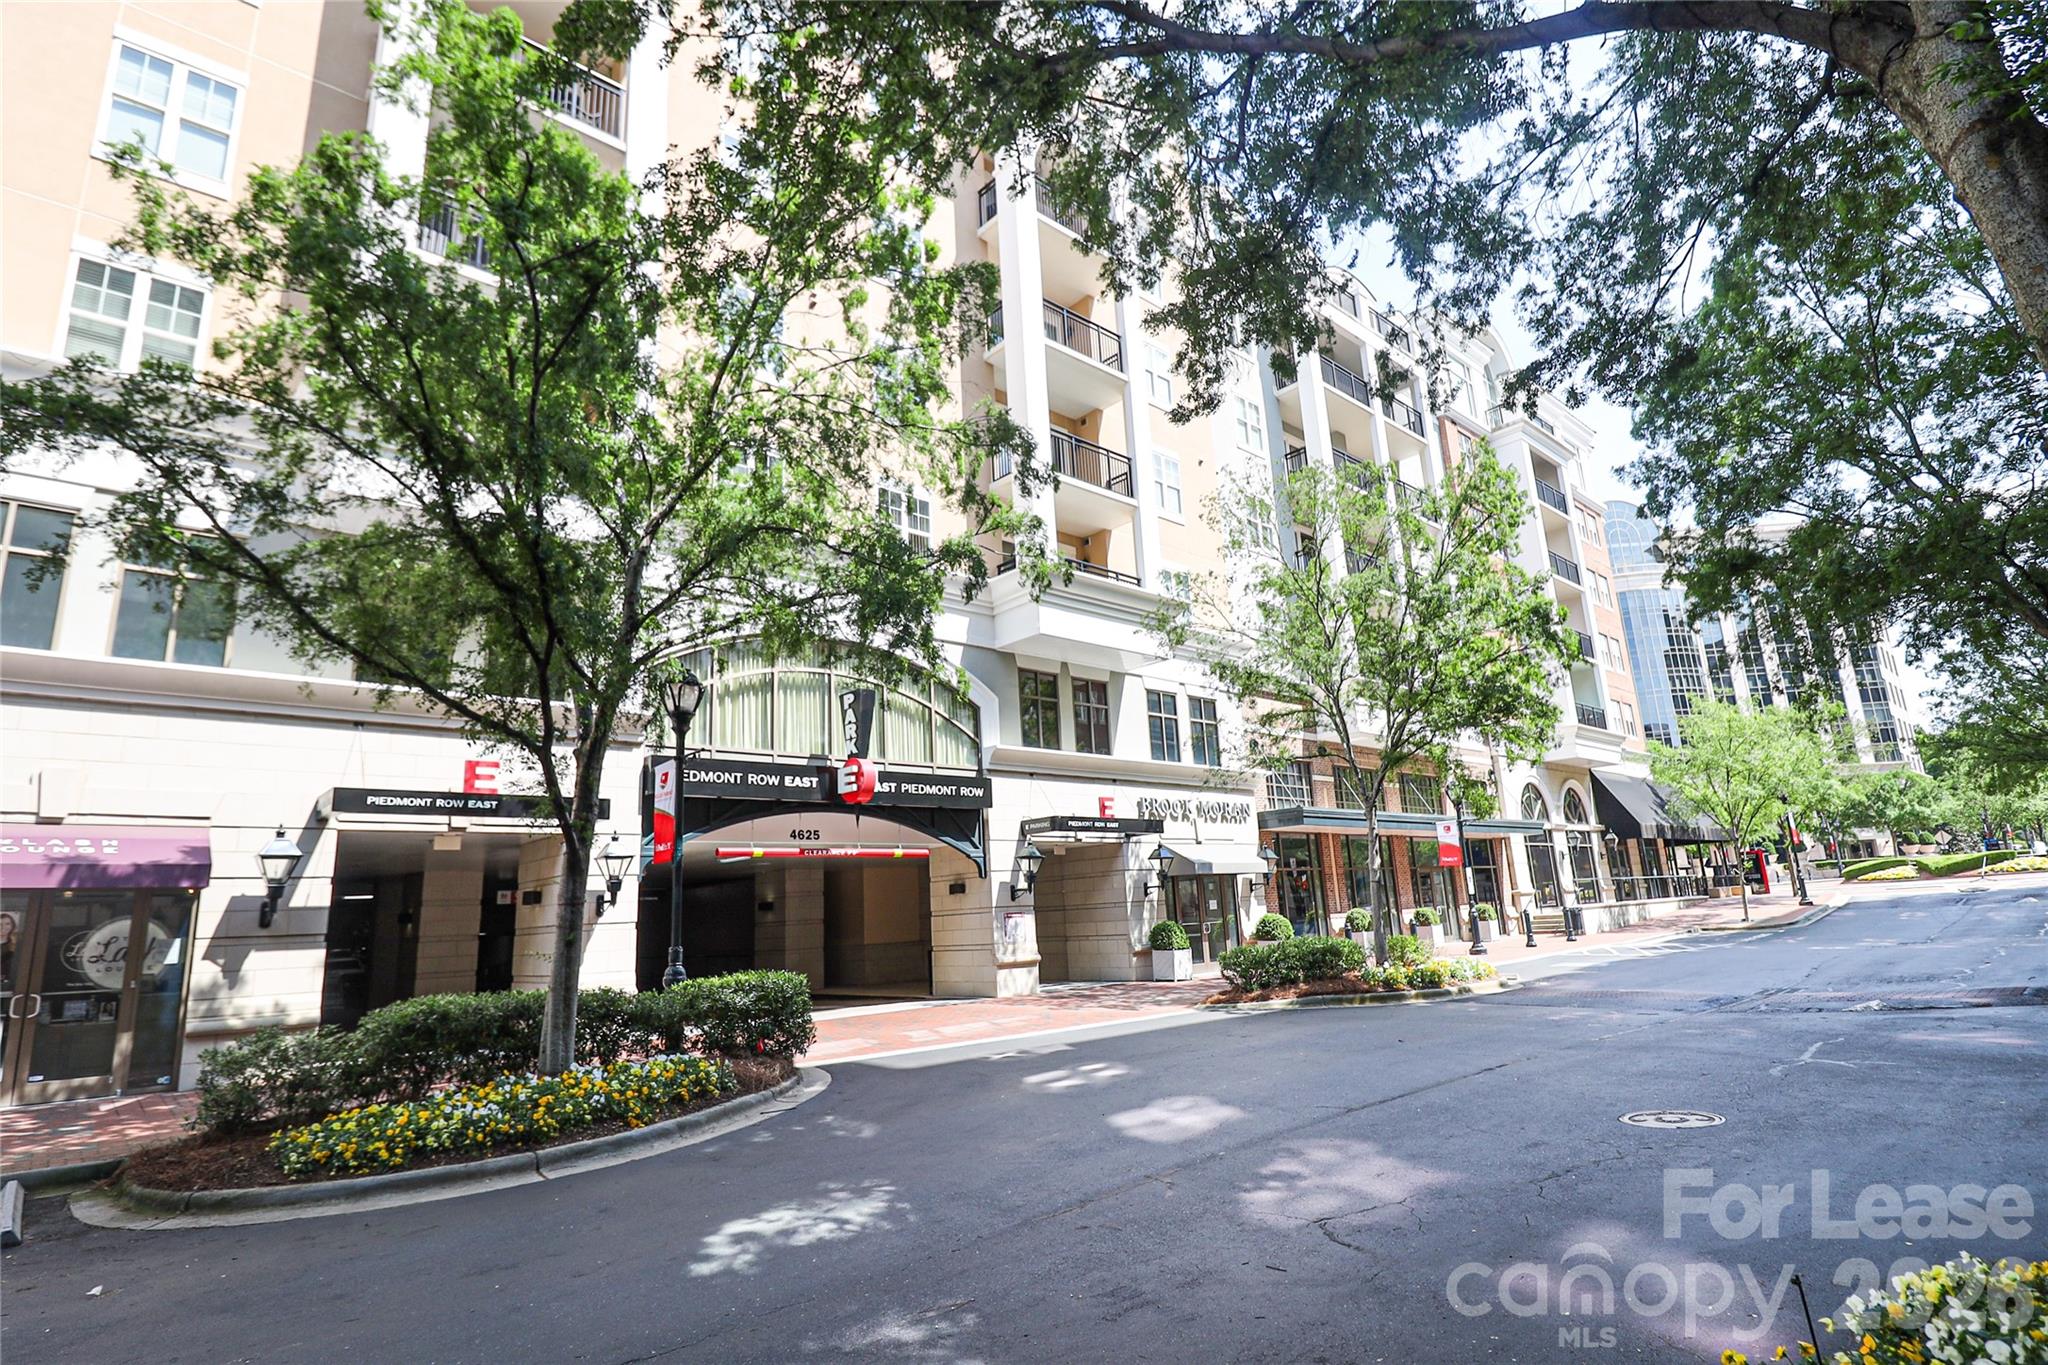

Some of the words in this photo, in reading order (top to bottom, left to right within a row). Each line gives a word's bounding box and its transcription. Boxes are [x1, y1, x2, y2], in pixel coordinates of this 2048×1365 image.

[843, 693, 859, 755] PARK
[464, 760, 500, 794] E
[683, 769, 743, 784] EDMONT
[748, 774, 780, 786] ROW
[784, 776, 818, 788] EAST
[901, 783, 957, 796] PIEDMONT
[960, 786, 984, 797] ROW
[367, 795, 433, 807] PIEDMONT
[436, 798, 464, 808] ROW
[468, 800, 498, 809] EAST
[1098, 797, 1114, 818] E
[1138, 797, 1193, 820] BROOK
[1196, 800, 1251, 821] MORAN
[789, 829, 821, 840] 4625
